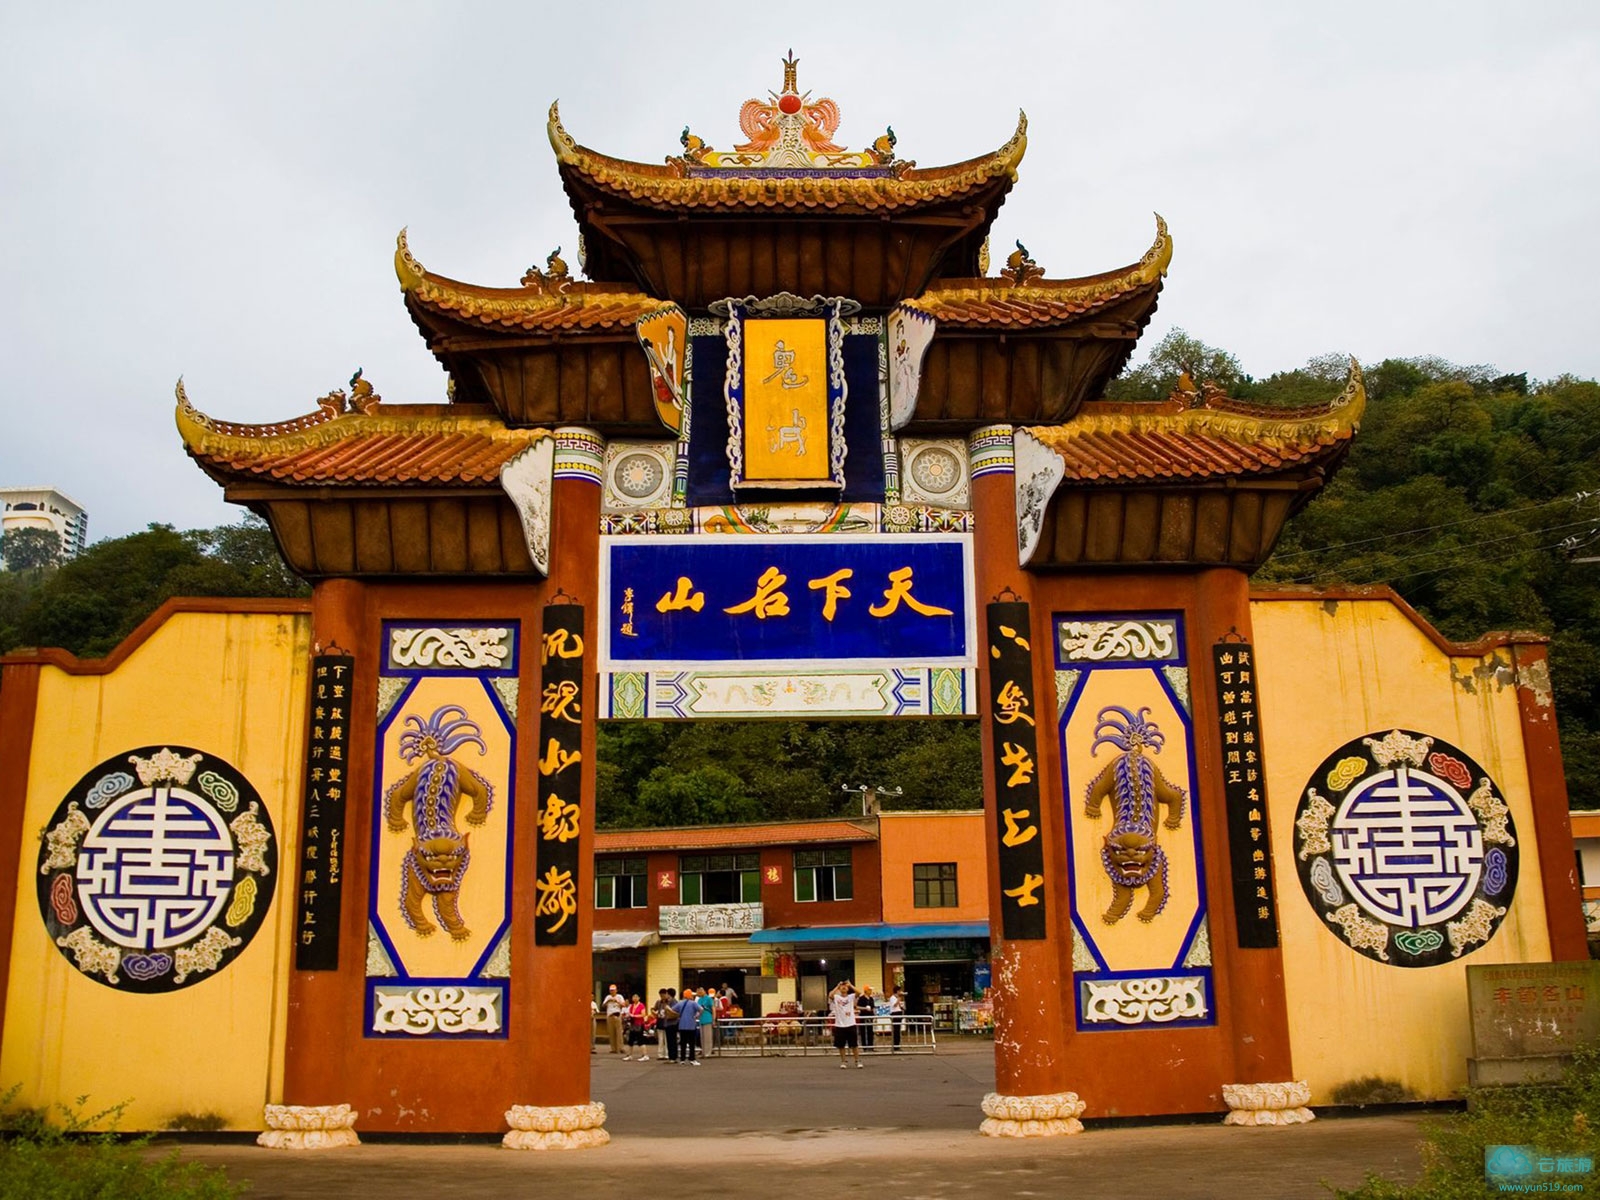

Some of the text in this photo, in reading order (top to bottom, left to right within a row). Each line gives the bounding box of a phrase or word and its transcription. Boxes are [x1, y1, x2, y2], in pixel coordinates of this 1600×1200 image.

[655, 565, 954, 622] 天下名山
[659, 873, 673, 887] 茶
[1493, 985, 1585, 1005] 丰都名山
